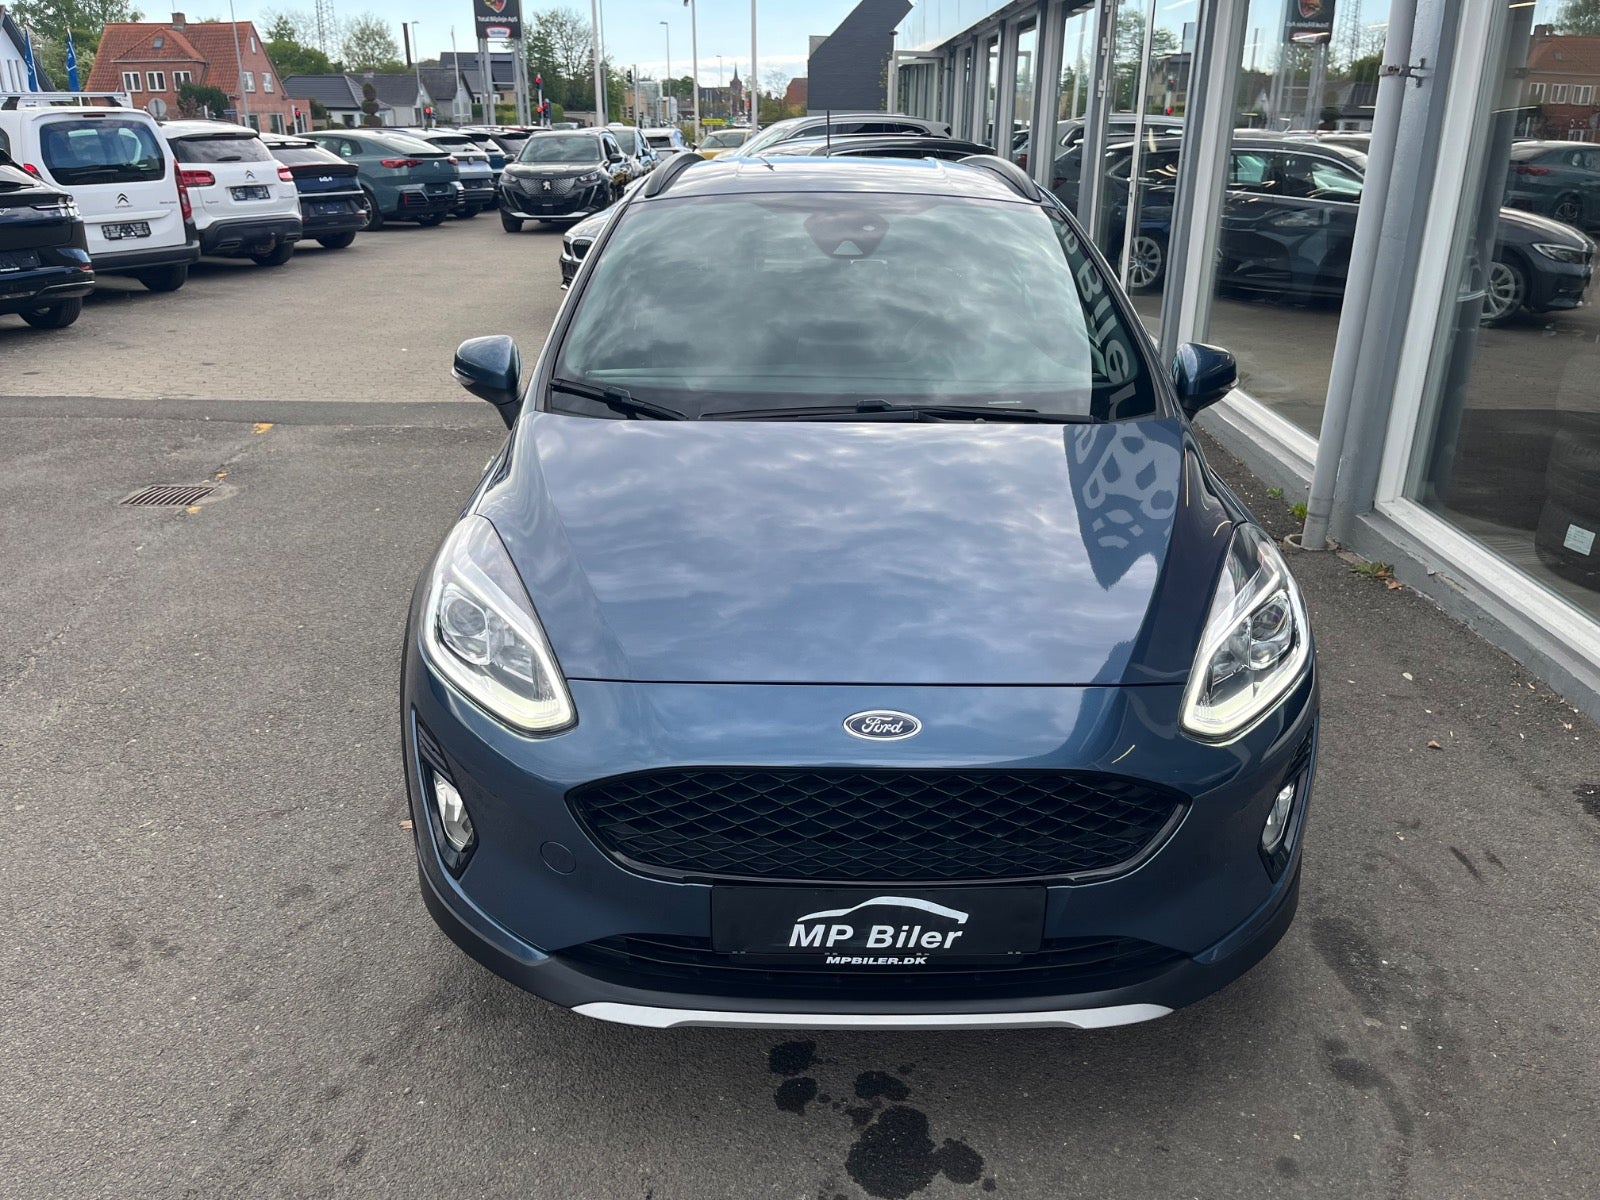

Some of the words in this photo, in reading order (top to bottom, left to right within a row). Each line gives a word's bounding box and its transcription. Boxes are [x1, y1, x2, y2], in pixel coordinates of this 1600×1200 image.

[861, 716, 904, 733] Ford
[788, 924, 854, 948] MP
[866, 925, 963, 949] Biler
[825, 956, 928, 965] MPBILER.DK
